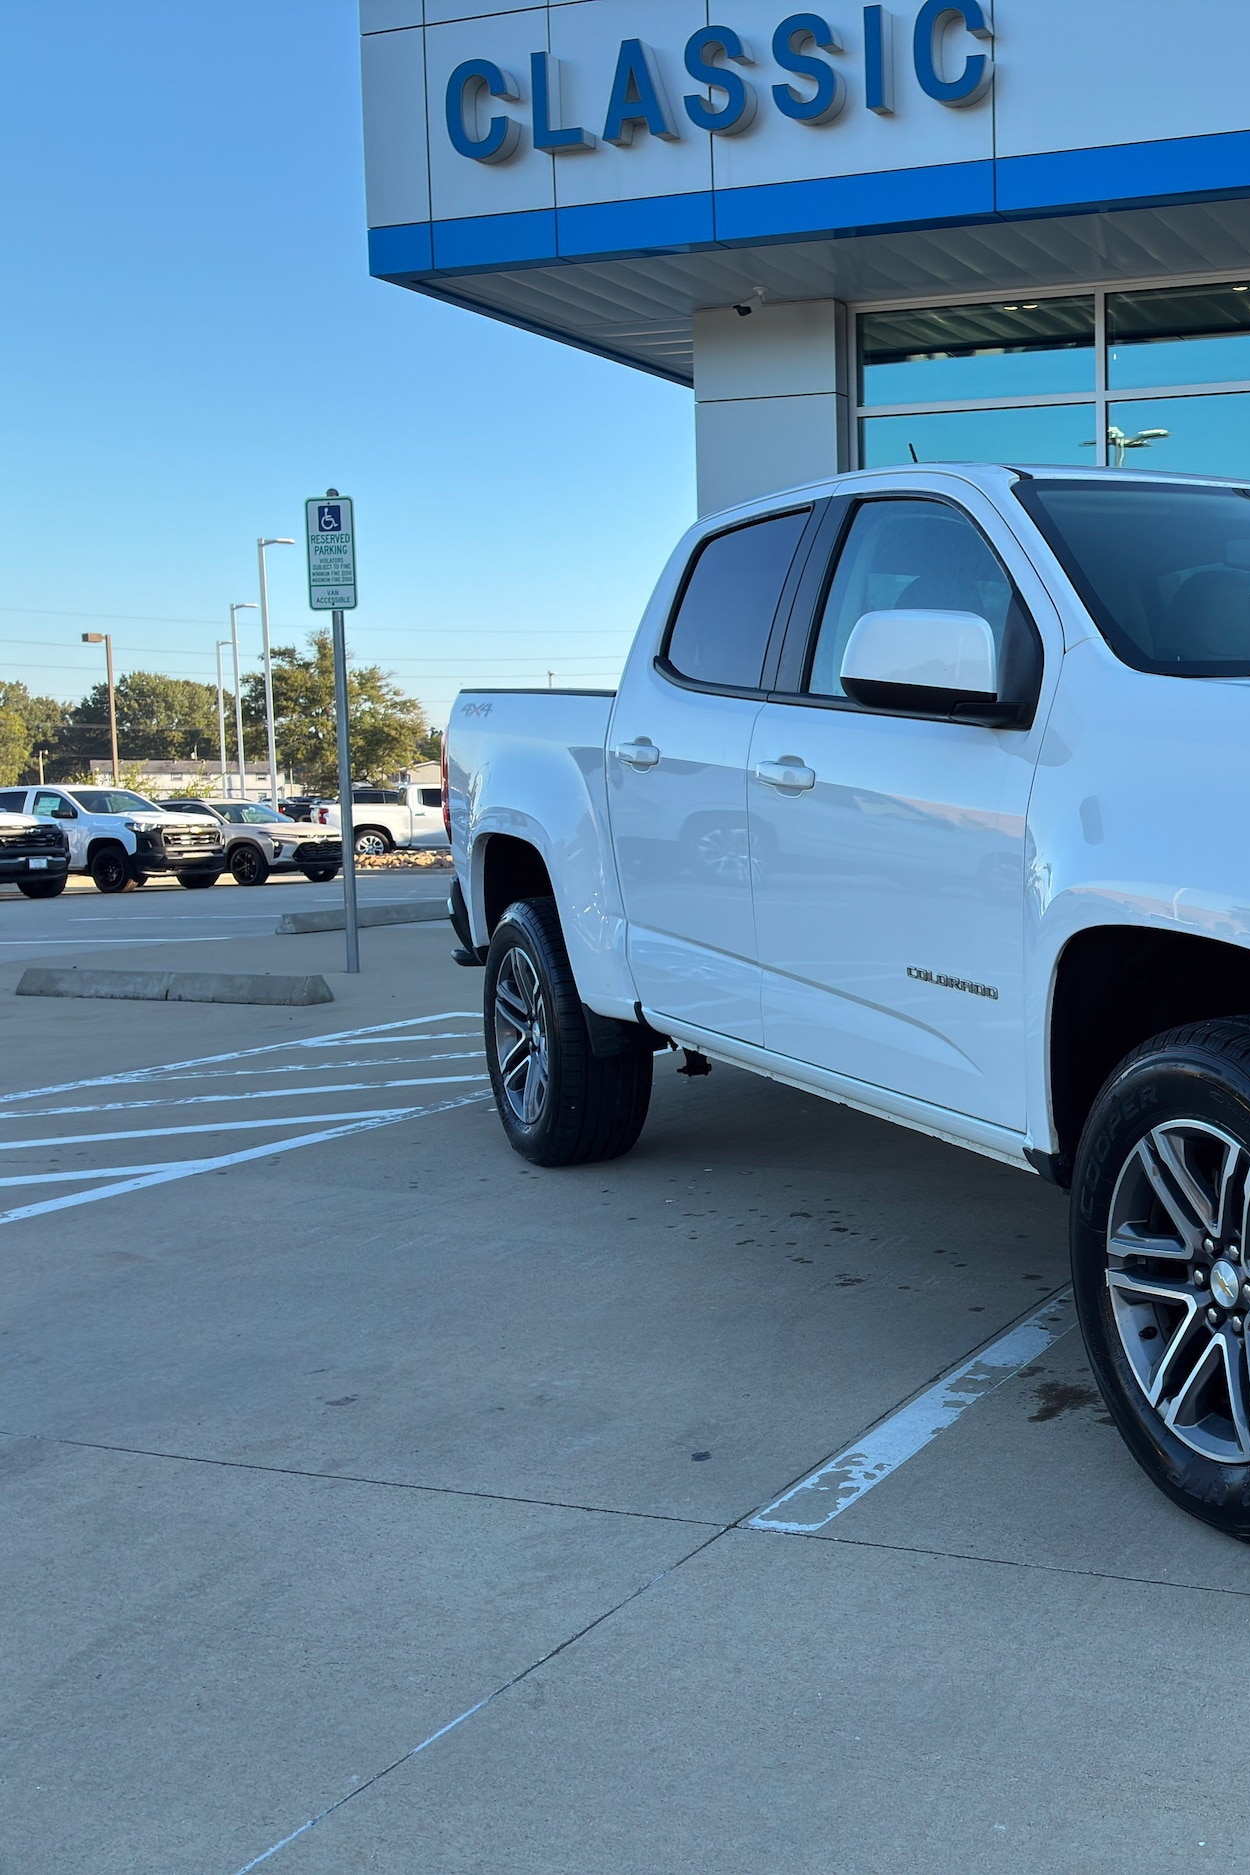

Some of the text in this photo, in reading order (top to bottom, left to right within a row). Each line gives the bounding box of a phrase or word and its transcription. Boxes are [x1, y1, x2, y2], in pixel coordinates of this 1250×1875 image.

[445, 0, 995, 165] CLASSIC
[310, 534, 350, 544] RESERVED
[314, 545, 347, 555] PARKING
[316, 596, 351, 604] ACCESSIBLE
[906, 966, 999, 1001] COLORADO
[1079, 1083, 1160, 1222] COOPER
